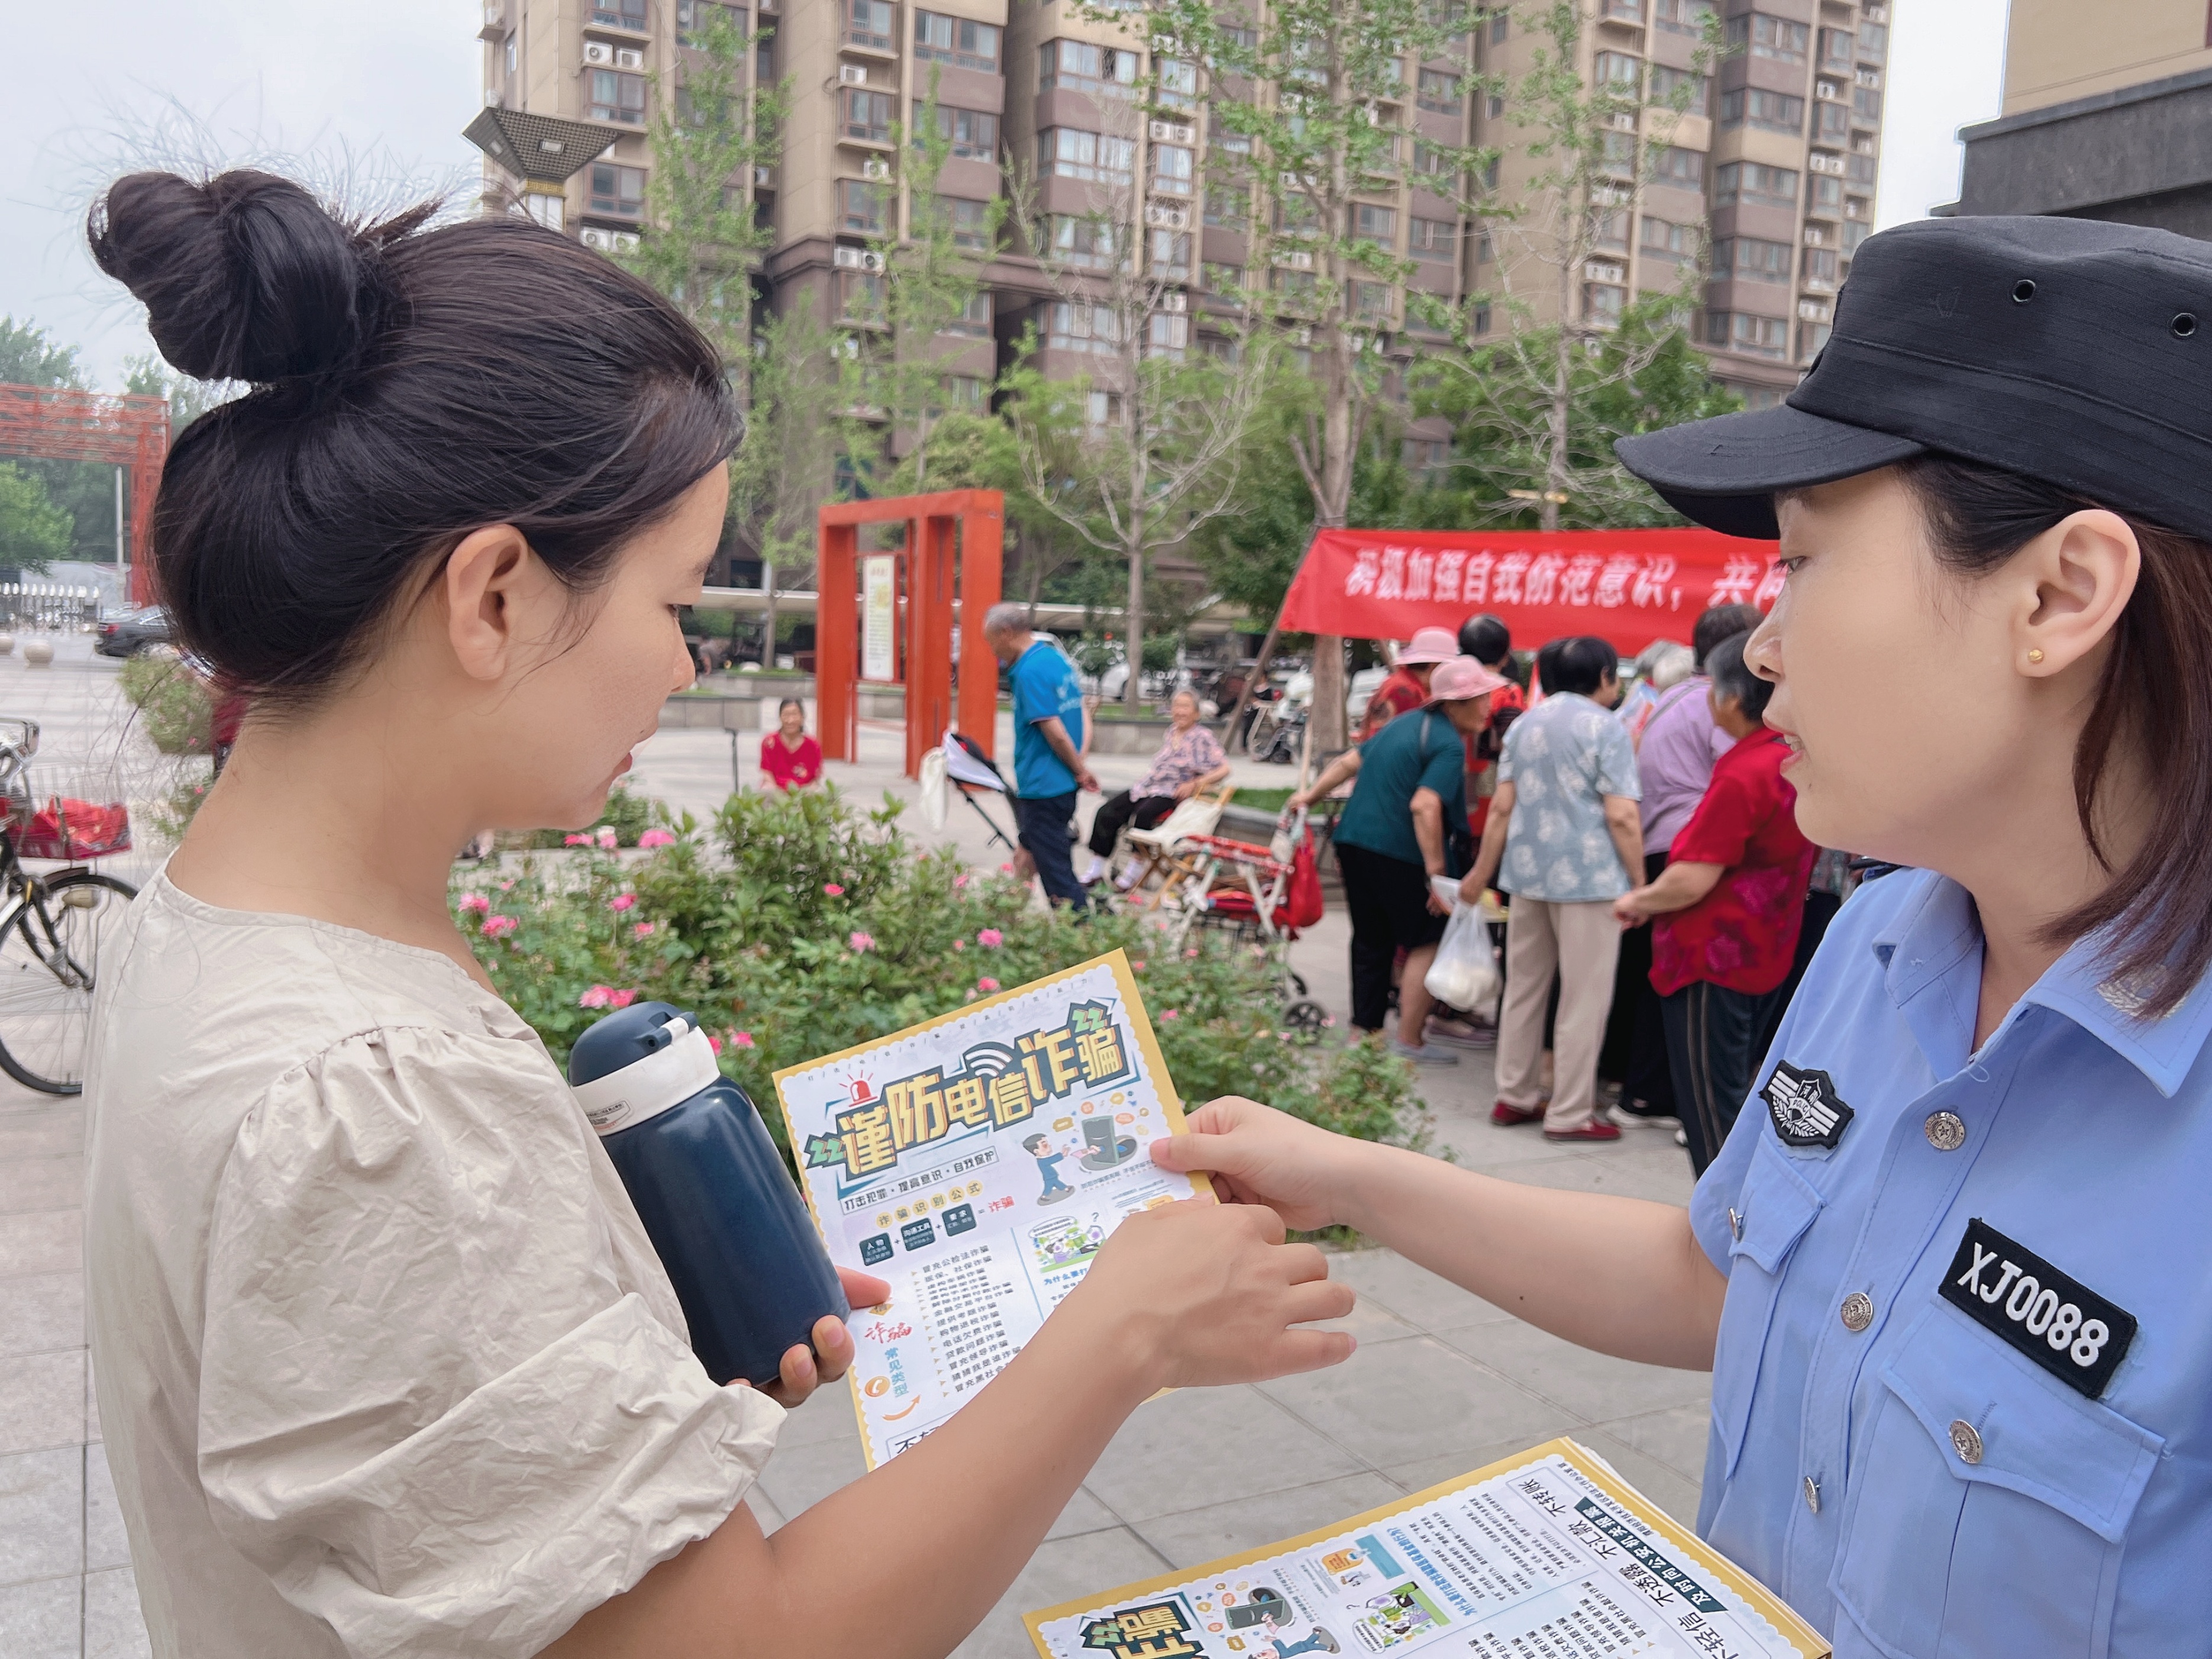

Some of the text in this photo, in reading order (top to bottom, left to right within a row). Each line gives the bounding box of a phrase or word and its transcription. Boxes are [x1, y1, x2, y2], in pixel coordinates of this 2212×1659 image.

[839, 1026, 1123, 1174] 谨防电信诈骗
[879, 1182, 981, 1226] 诈骗识别公式
[988, 1195, 1016, 1213] 诈骗
[1957, 1241, 2110, 1367] XJ0088
[864, 1321, 913, 1344] 诈骗
[942, 1320, 1003, 1347] 电话欠费诈骗
[946, 1329, 1006, 1359] 贷款问题诈骗
[884, 1347, 909, 1397] 常见类型
[949, 1340, 1009, 1370] 冒充领导诈骗
[955, 1362, 1009, 1392] 冒充黑社会
[895, 1425, 940, 1454] 不
[1518, 1478, 1739, 1659] 不轻信 不透露 不汇款 不转账
[1583, 1505, 1712, 1606] 及时向公安机关报案
[1571, 1610, 1616, 1652] 冒充领导诈骗
[1579, 1598, 1632, 1645] 猜猜我是谁诈骗
